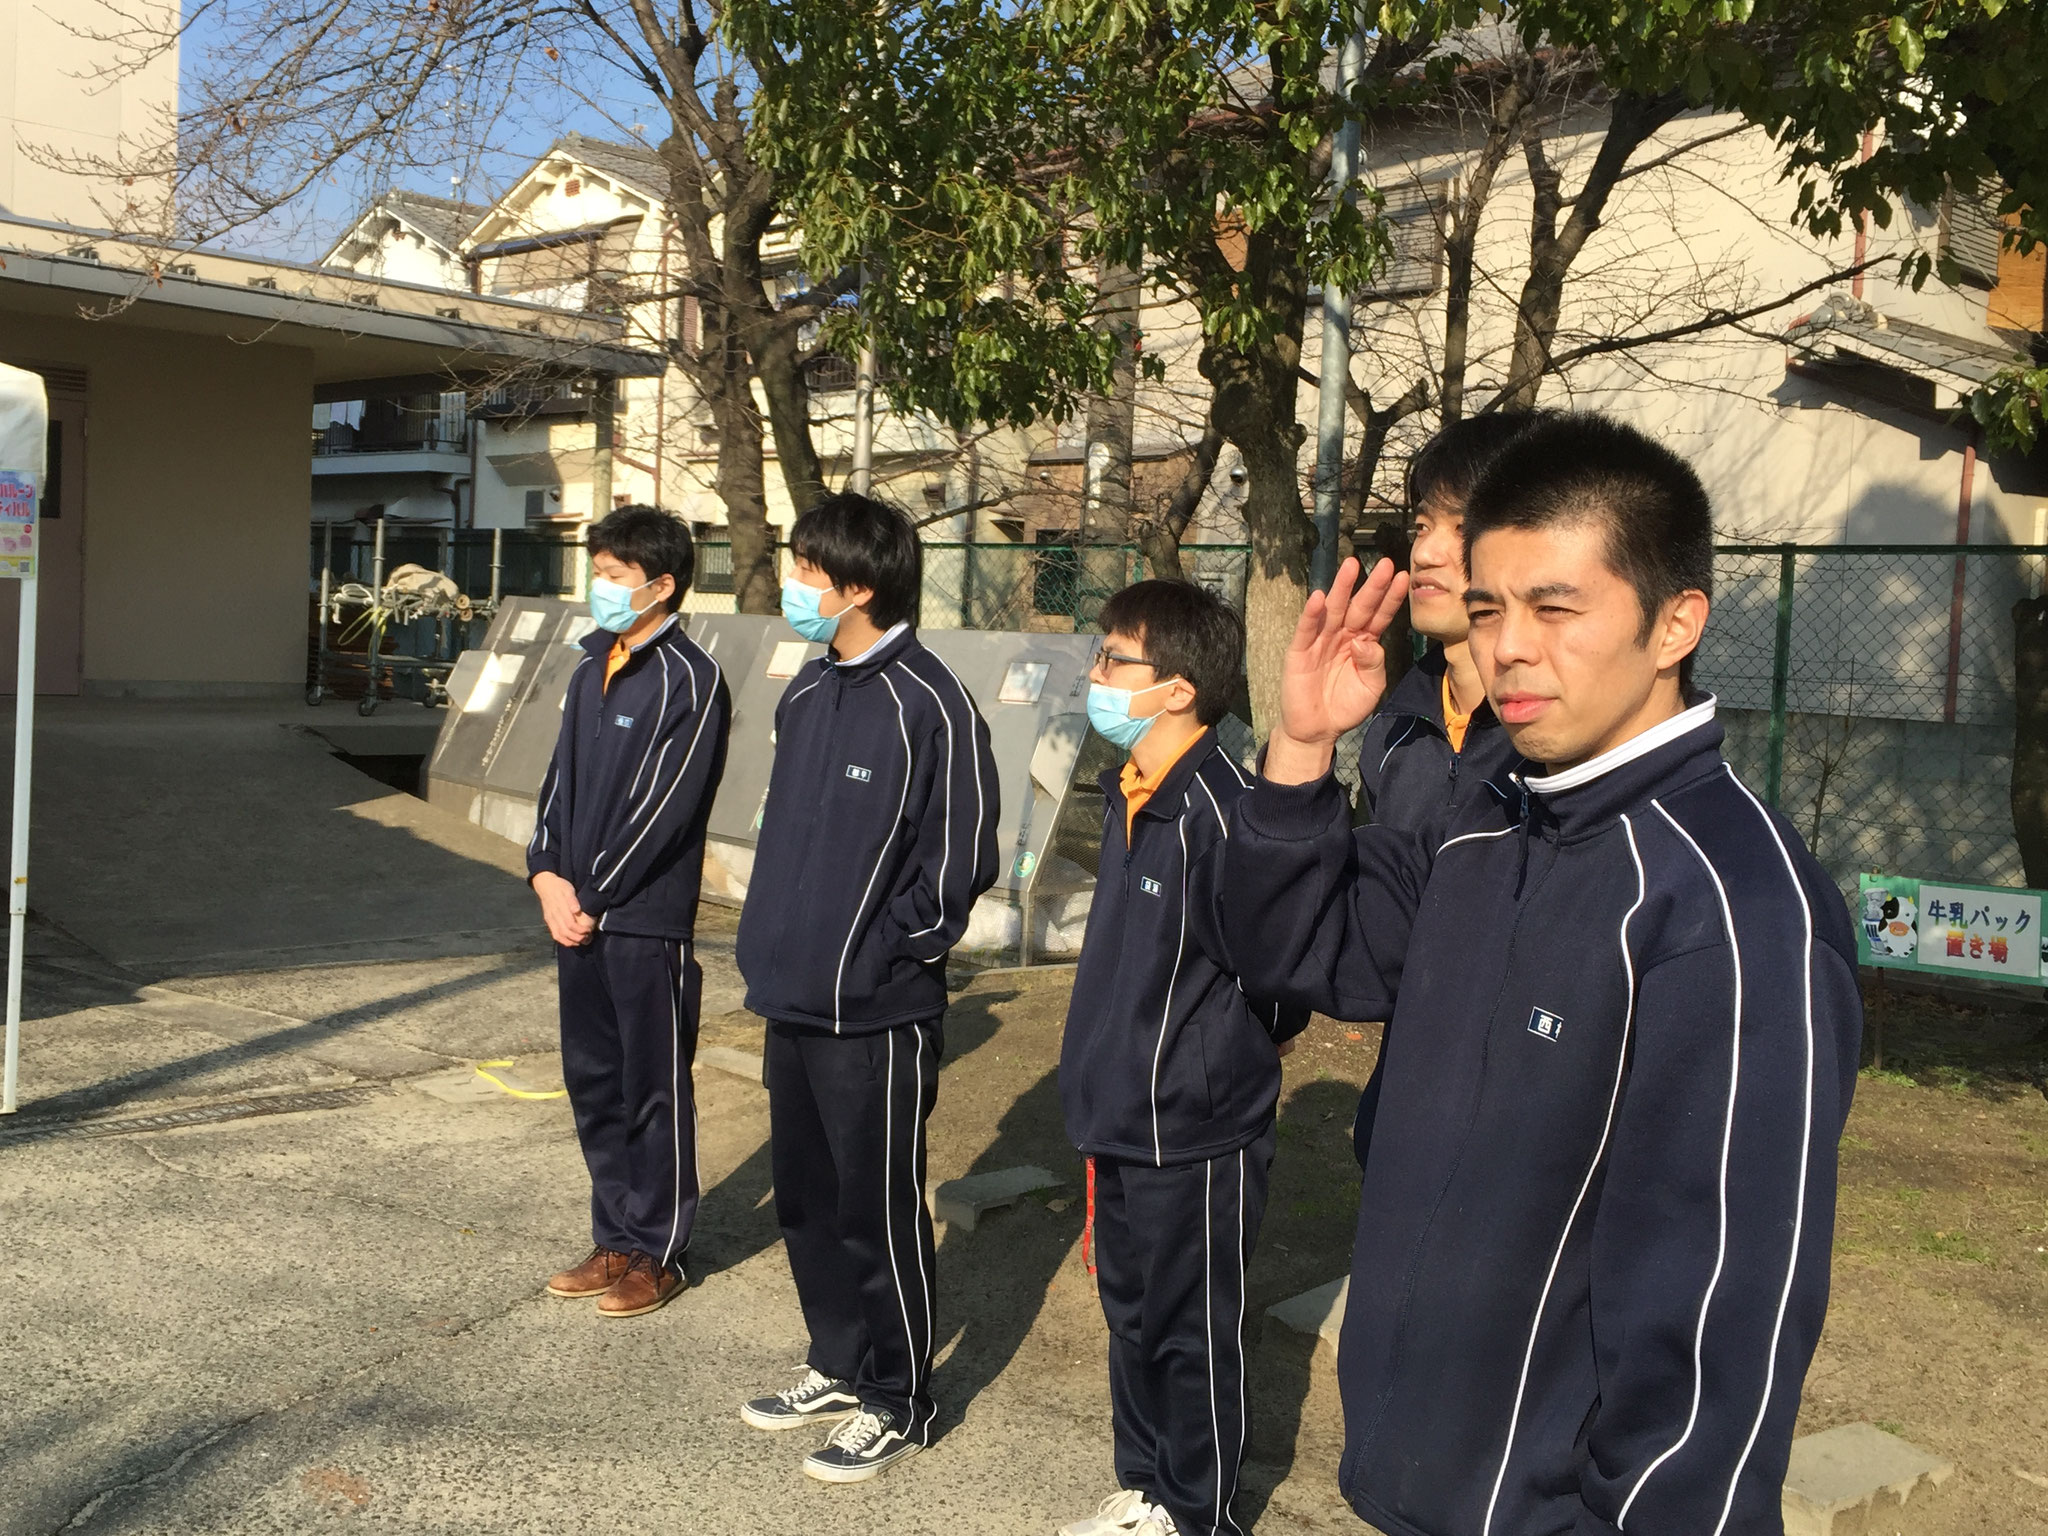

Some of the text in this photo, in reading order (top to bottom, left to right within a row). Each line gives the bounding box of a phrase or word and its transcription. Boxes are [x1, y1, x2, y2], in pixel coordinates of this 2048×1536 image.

[1927, 899, 2032, 934] 牛乳パック
[1946, 929, 2009, 964] 置き場
